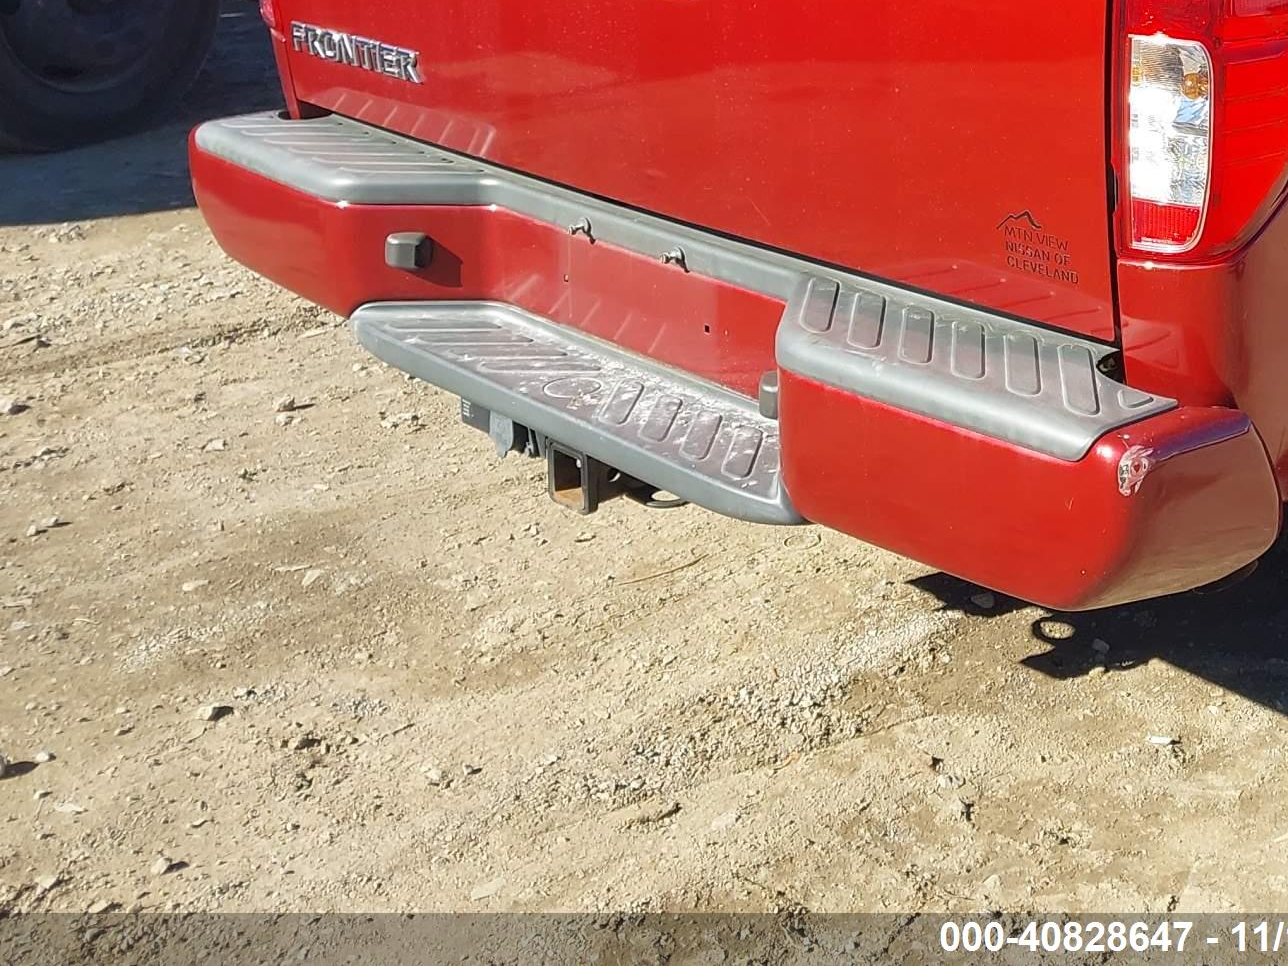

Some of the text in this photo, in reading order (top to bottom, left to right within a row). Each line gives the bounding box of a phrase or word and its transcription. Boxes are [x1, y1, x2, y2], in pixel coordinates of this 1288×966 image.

[291, 20, 424, 84] FRONTIER
[1005, 241, 1070, 267] NISSAN OF
[1036, 233, 1068, 250] VIEW
[1007, 255, 1079, 284] CLEVELAND
